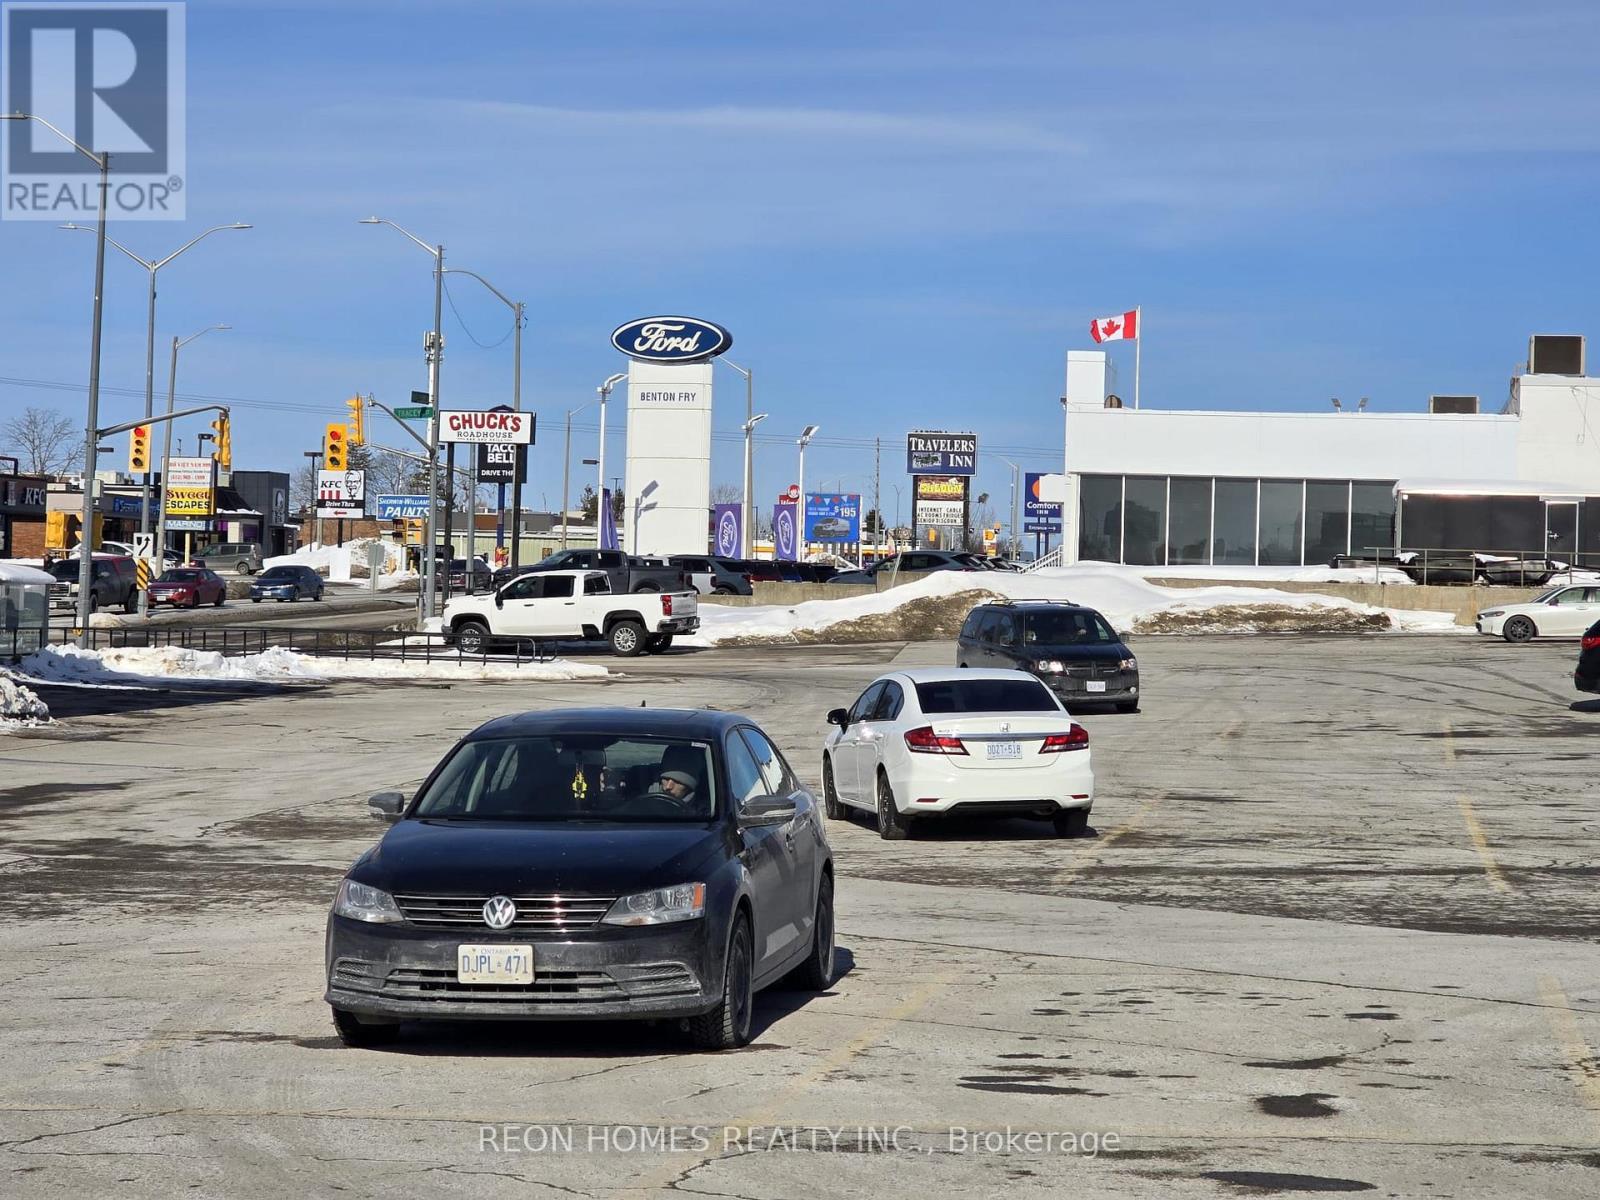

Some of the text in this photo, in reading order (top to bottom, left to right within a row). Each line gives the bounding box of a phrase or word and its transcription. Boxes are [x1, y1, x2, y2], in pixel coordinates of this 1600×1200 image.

[634, 323, 702, 351] Ford
[640, 392, 696, 401] BENTON FRY
[449, 413, 522, 432] CHUCK'S
[457, 431, 513, 439] ROADHOUSE
[909, 437, 975, 452] TRAVELERS
[949, 454, 973, 467] INN
[321, 480, 342, 488] KFC
[25, 487, 46, 505] KFC
[165, 500, 210, 509] ESCAPES
[1027, 501, 1058, 509] Comfort
[384, 506, 430, 517] PAINTS
[723, 521, 733, 549] Ford
[462, 955, 528, 974] DJPL 471
